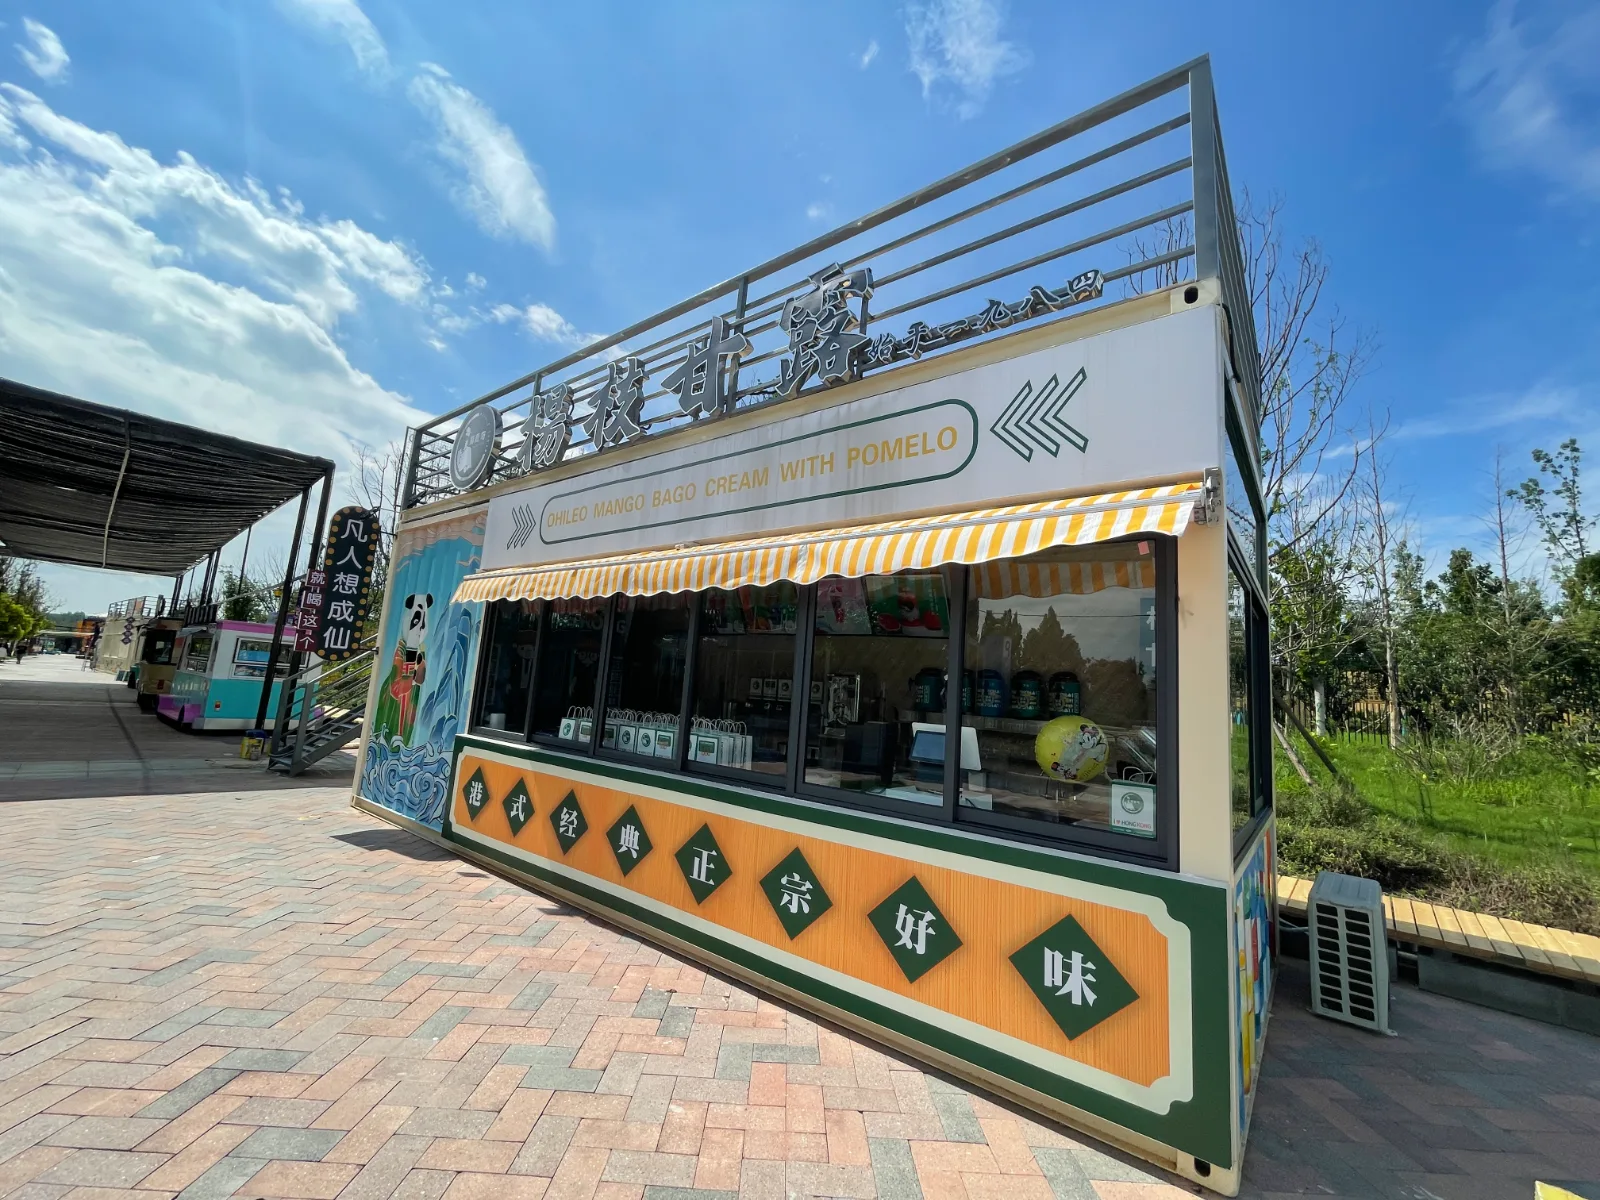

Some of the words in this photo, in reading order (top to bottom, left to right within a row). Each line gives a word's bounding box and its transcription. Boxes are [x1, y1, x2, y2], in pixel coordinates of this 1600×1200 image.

[593, 494, 645, 519] MANGO
[651, 482, 697, 508] BAGO
[704, 469, 769, 497] CREAM
[779, 452, 834, 484] WITH
[846, 425, 958, 470] POMELO
[299, 570, 327, 650] 就喝这个
[323, 518, 368, 651] 凡人想成仙
